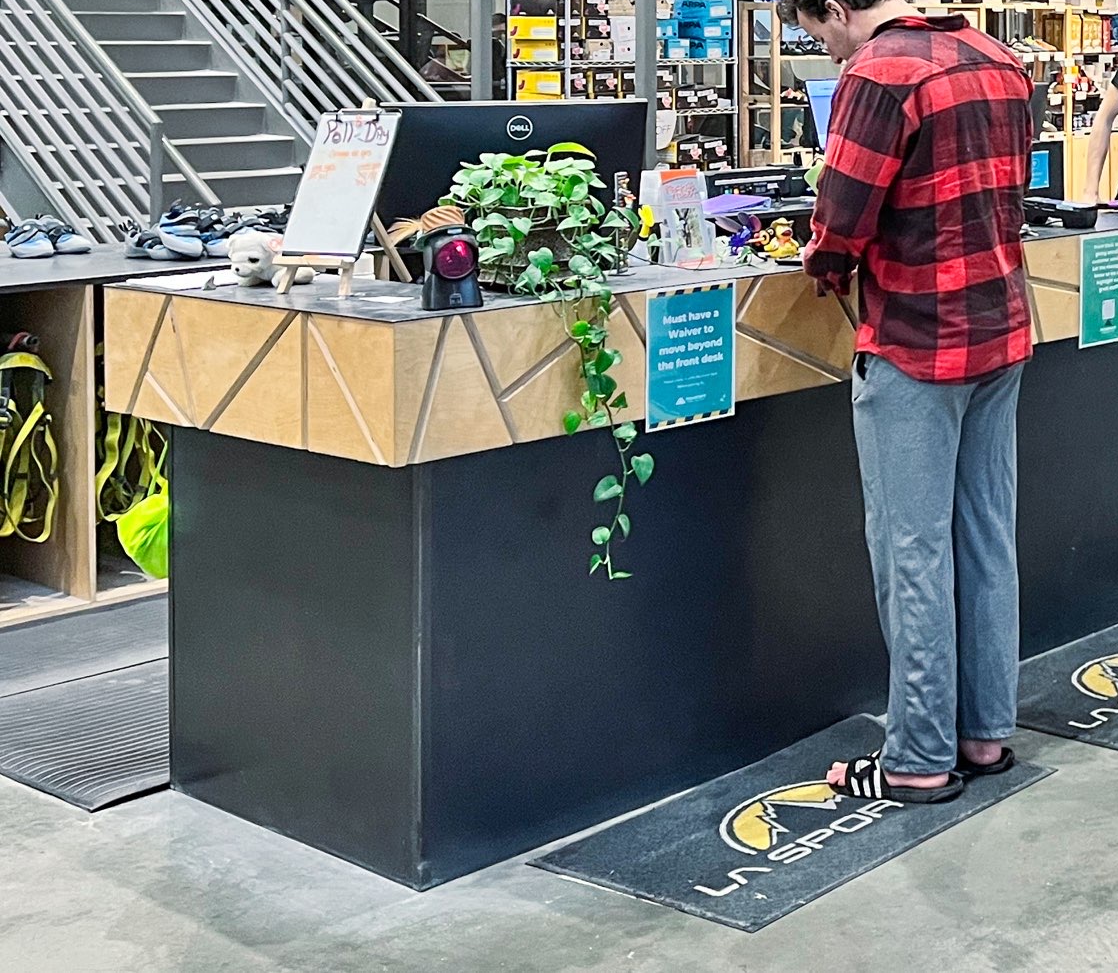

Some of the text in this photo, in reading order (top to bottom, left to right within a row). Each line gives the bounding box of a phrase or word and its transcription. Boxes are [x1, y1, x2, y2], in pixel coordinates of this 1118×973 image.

[510, 124, 530, 132] DELL
[663, 310, 719, 325] Must have a
[668, 325, 714, 339] Waiver to
[659, 337, 723, 356] move beyond
[658, 352, 724, 371] the front desk
[693, 799, 904, 897] LA SPOR
